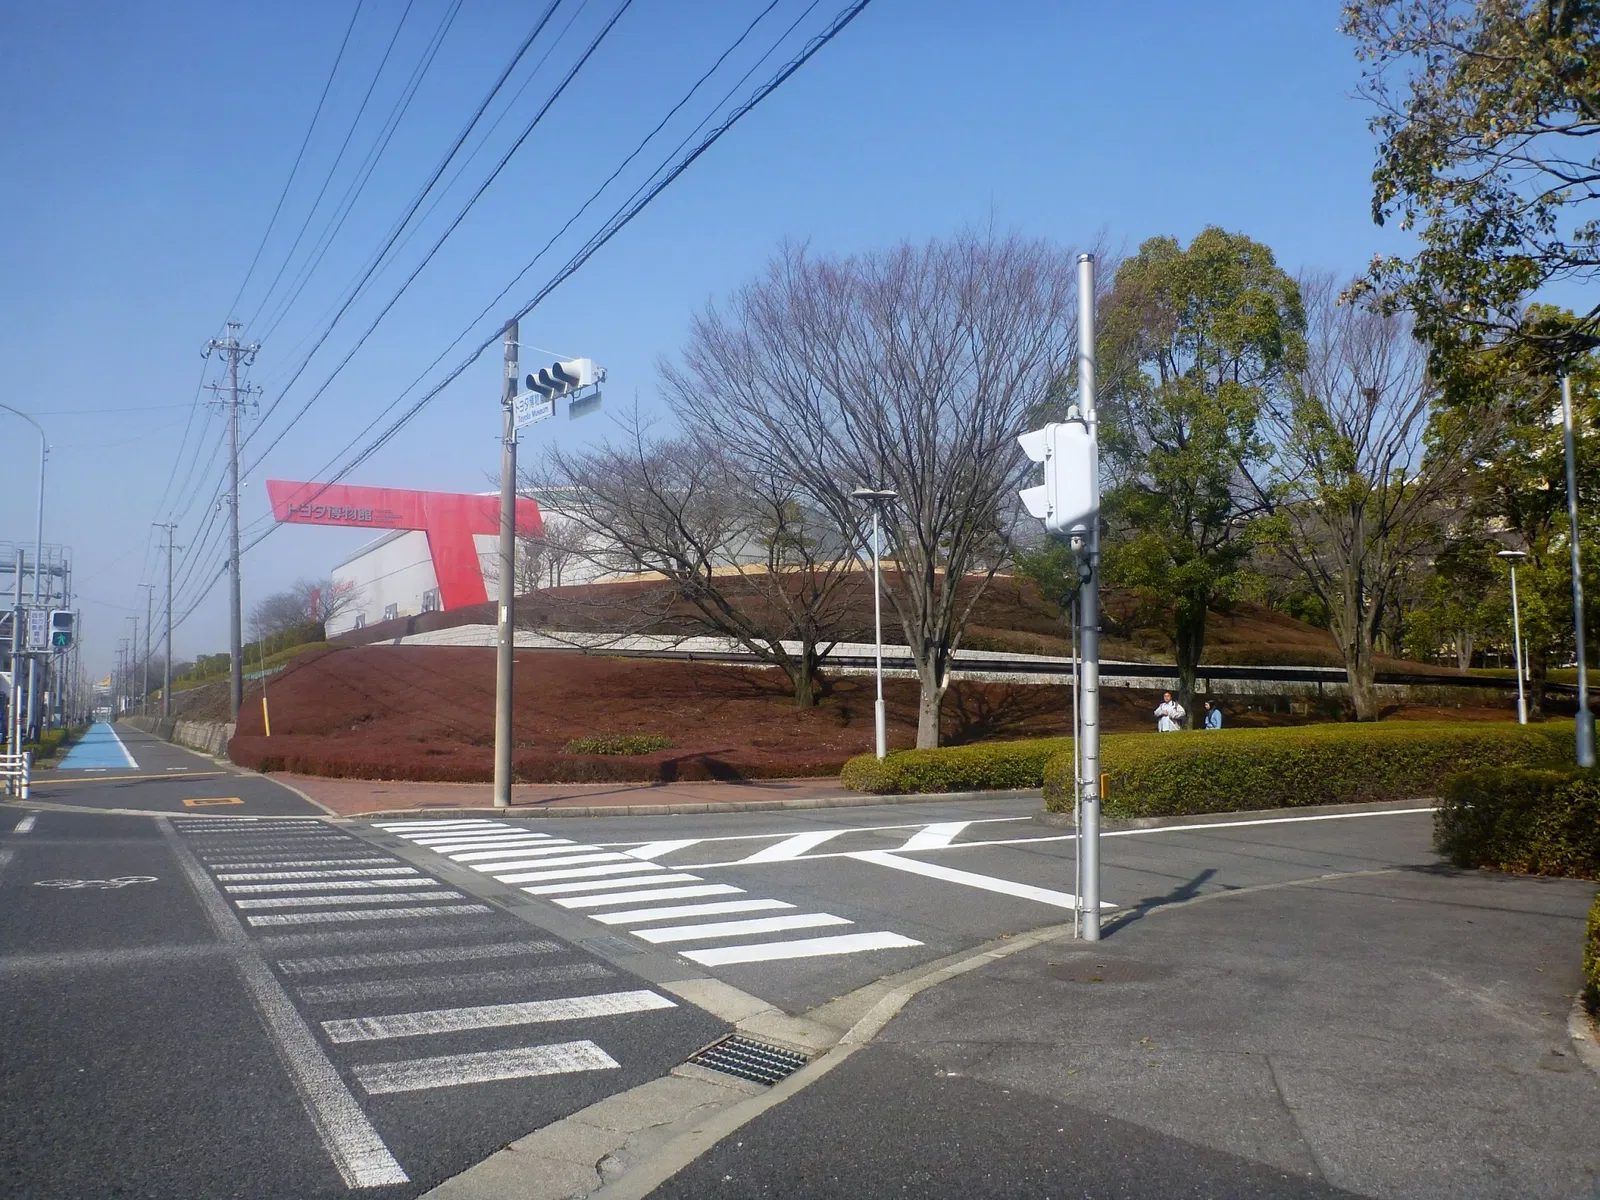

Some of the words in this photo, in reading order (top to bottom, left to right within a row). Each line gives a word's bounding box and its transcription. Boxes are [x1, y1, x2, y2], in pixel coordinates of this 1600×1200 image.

[531, 406, 548, 418] Museum
[288, 504, 373, 522] トヨタ博物館
